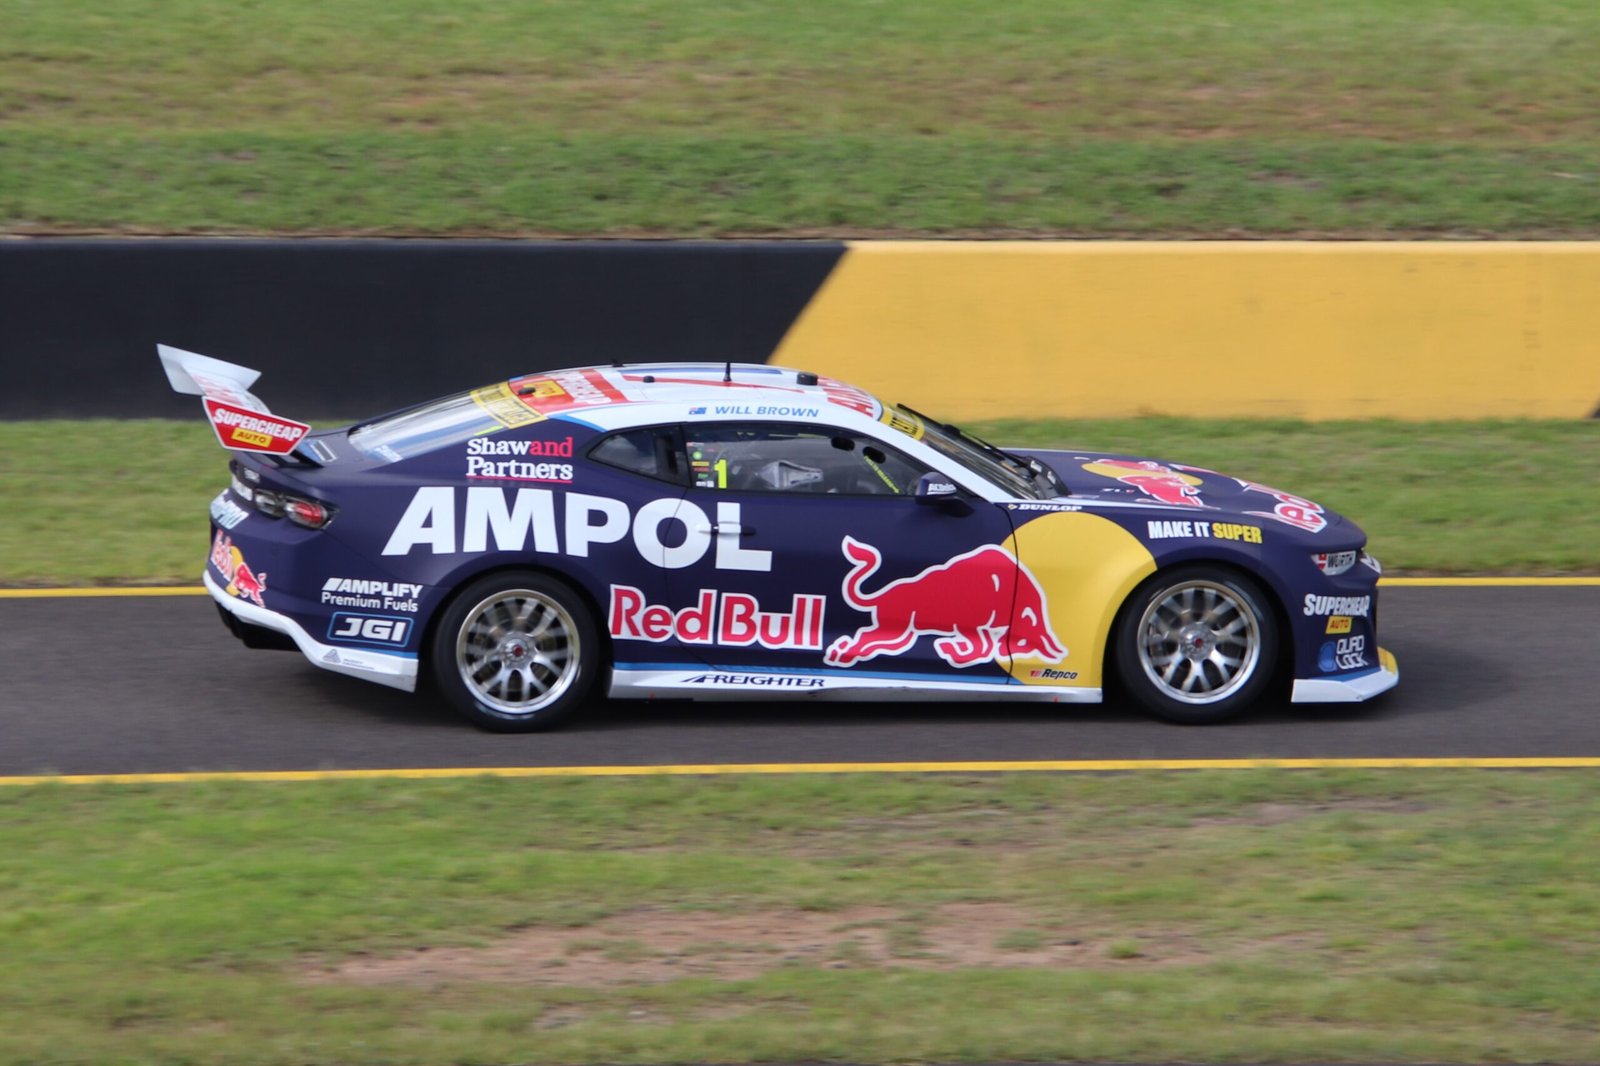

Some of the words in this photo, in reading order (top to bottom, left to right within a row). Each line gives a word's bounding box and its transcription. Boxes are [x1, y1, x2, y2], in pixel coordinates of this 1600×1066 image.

[714, 405, 753, 416] WILL
[756, 406, 820, 418] BROWN
[214, 408, 303, 441] SUPERCHEAP
[236, 430, 267, 444] AUTO
[466, 456, 574, 480] Partners
[713, 458, 728, 489] 1
[1017, 503, 1083, 512] DUNLOP
[380, 486, 773, 572] AMPOL
[1147, 520, 1193, 539] MAKE
[1195, 521, 1211, 538] IT
[1211, 522, 1263, 544] SUPER
[339, 578, 424, 599] AMPLIFY
[321, 591, 382, 609] Premium
[383, 598, 419, 612] Fuels
[1303, 593, 1370, 617] SUPERCHEAP
[334, 617, 407, 642] JGI
[1329, 618, 1351, 630] AUTO
[1041, 667, 1079, 680] Repco
